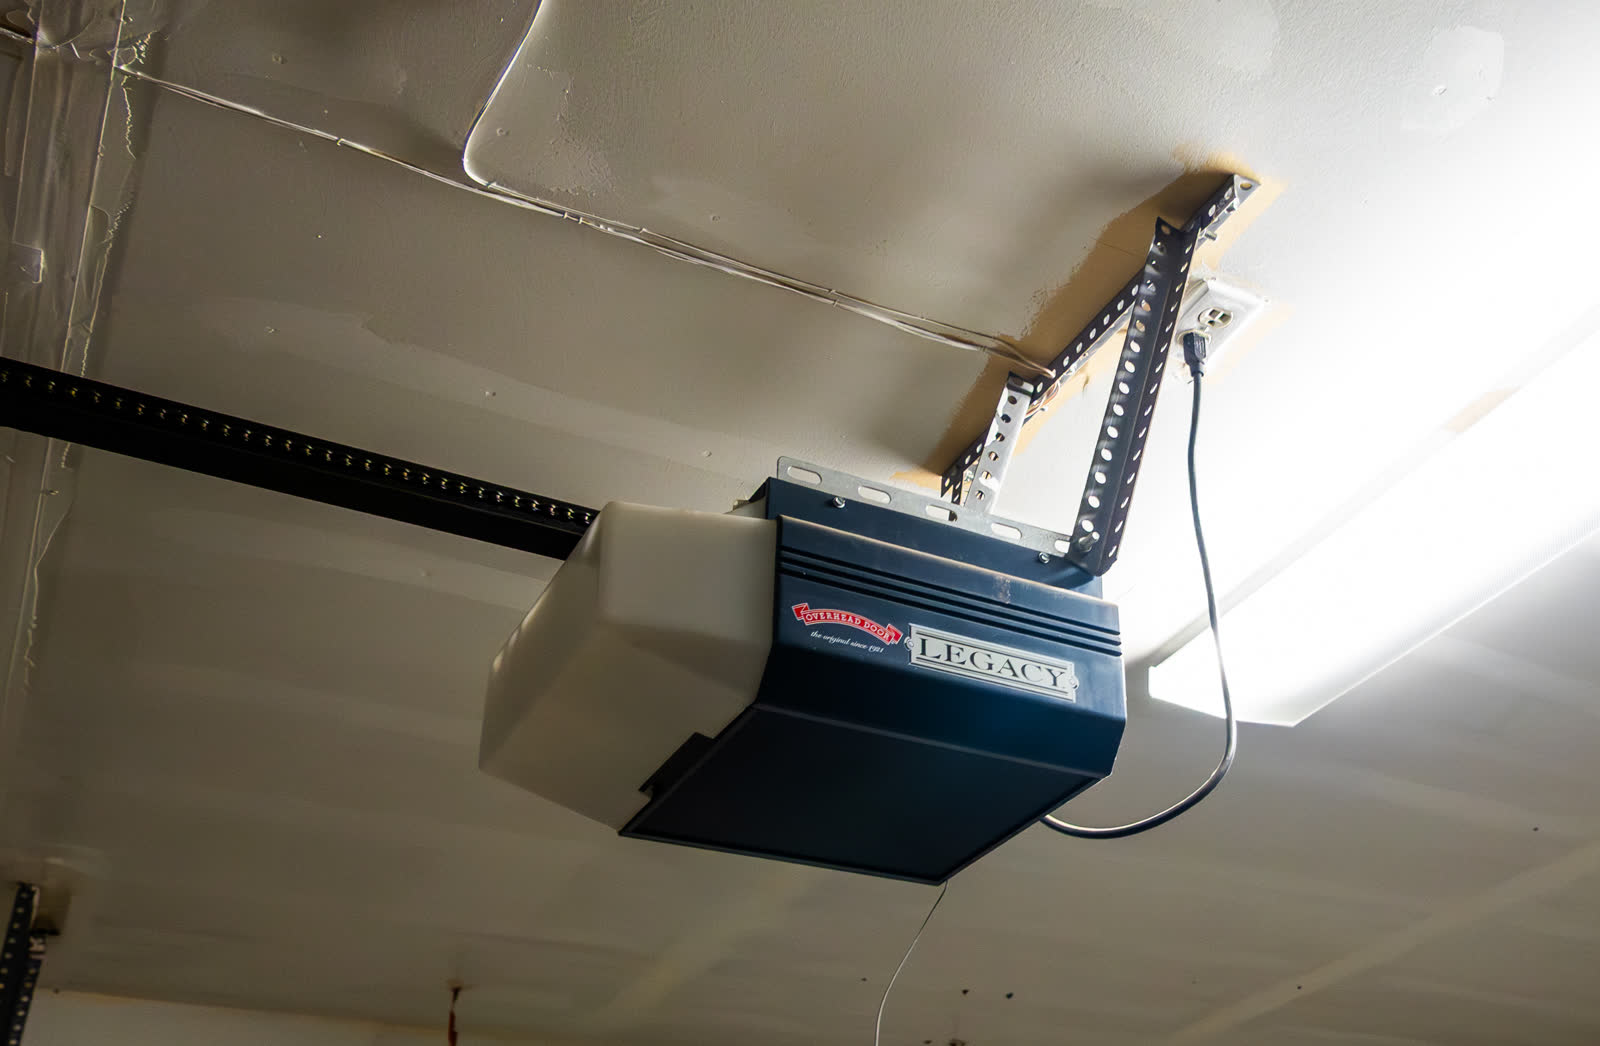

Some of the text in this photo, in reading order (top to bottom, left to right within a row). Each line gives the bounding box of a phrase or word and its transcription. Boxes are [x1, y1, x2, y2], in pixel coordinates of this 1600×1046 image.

[805, 612, 891, 640] OVERHEAD DOOR
[810, 630, 822, 639] the
[823, 634, 851, 645] original
[850, 640, 868, 650] since
[919, 638, 1065, 687] LEGACY
